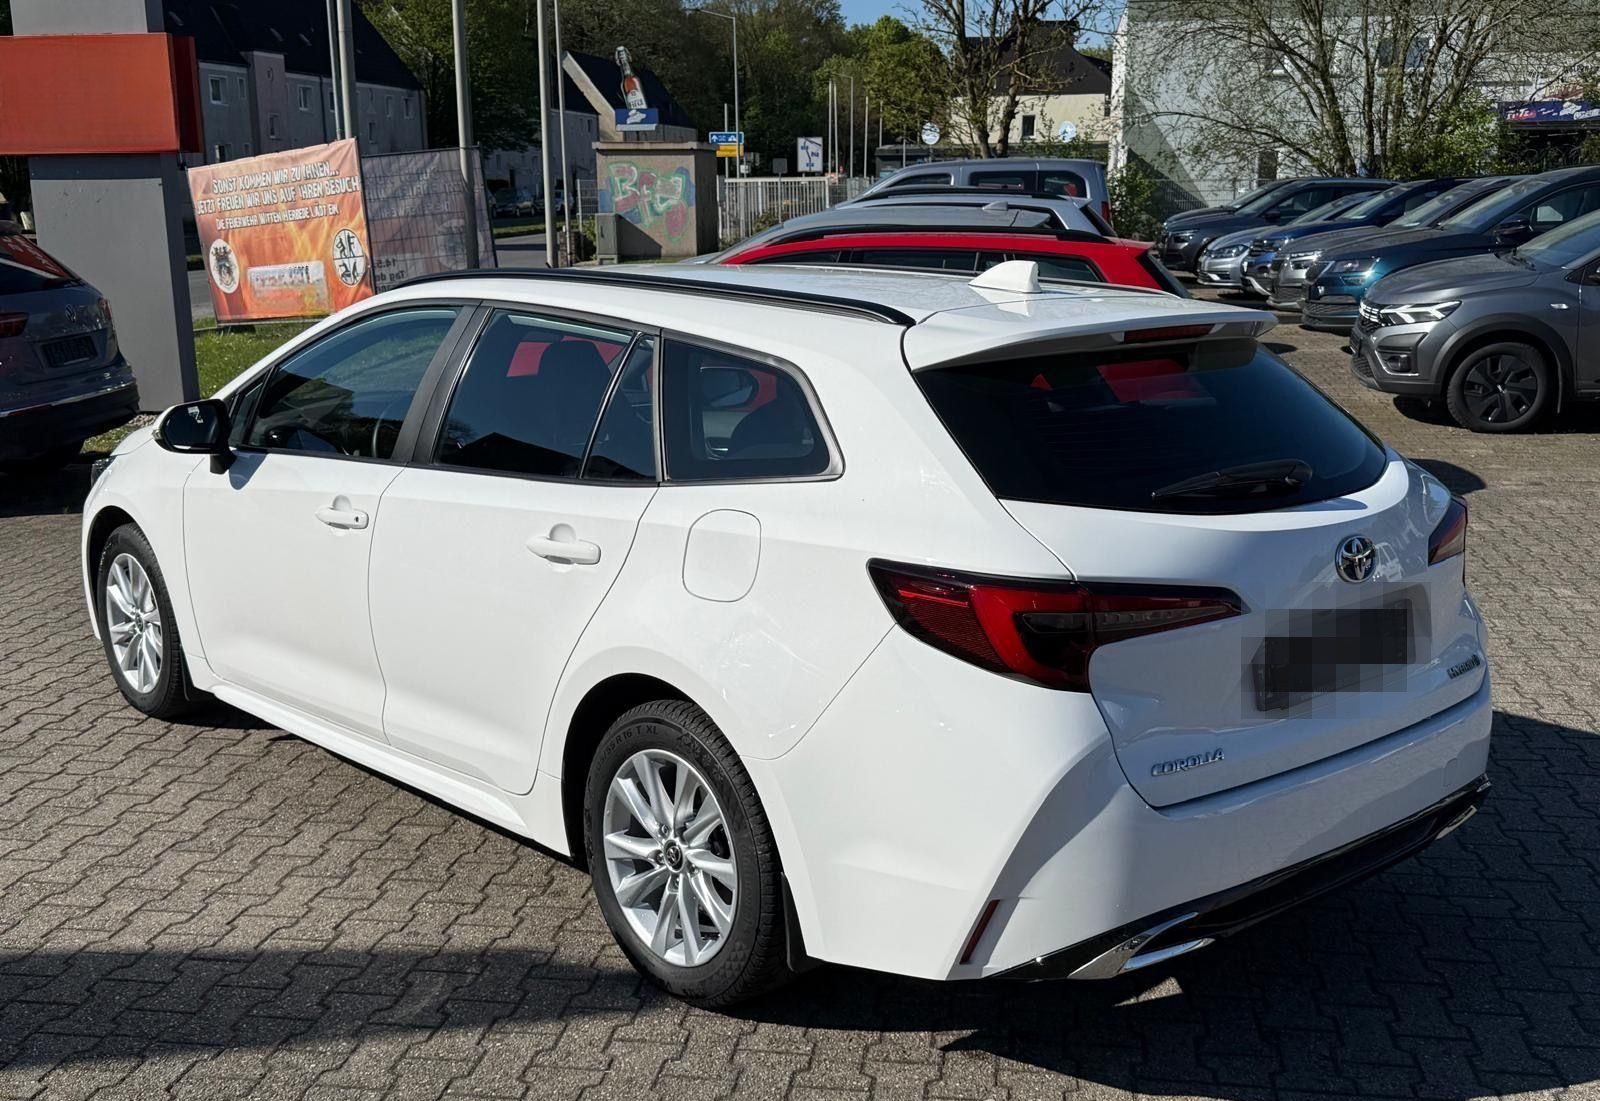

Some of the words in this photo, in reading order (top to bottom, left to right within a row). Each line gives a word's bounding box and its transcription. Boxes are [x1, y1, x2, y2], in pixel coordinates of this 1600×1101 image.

[212, 176, 237, 194] SONST
[239, 171, 273, 191] KOMMEN
[273, 168, 289, 185] WIR
[290, 167, 301, 182] ZU
[196, 198, 216, 215] JETZT
[217, 195, 245, 213] FREUEN
[246, 191, 261, 208] WIR
[262, 189, 278, 206] UNS
[280, 187, 297, 203] AUF
[299, 182, 324, 201] IHREN
[324, 175, 360, 197] BESUCH
[216, 217, 226, 230] DIE
[226, 214, 258, 229] FEUERWEHR
[259, 210, 282, 225] WITTEN
[1151, 747, 1225, 777] COROLLA
